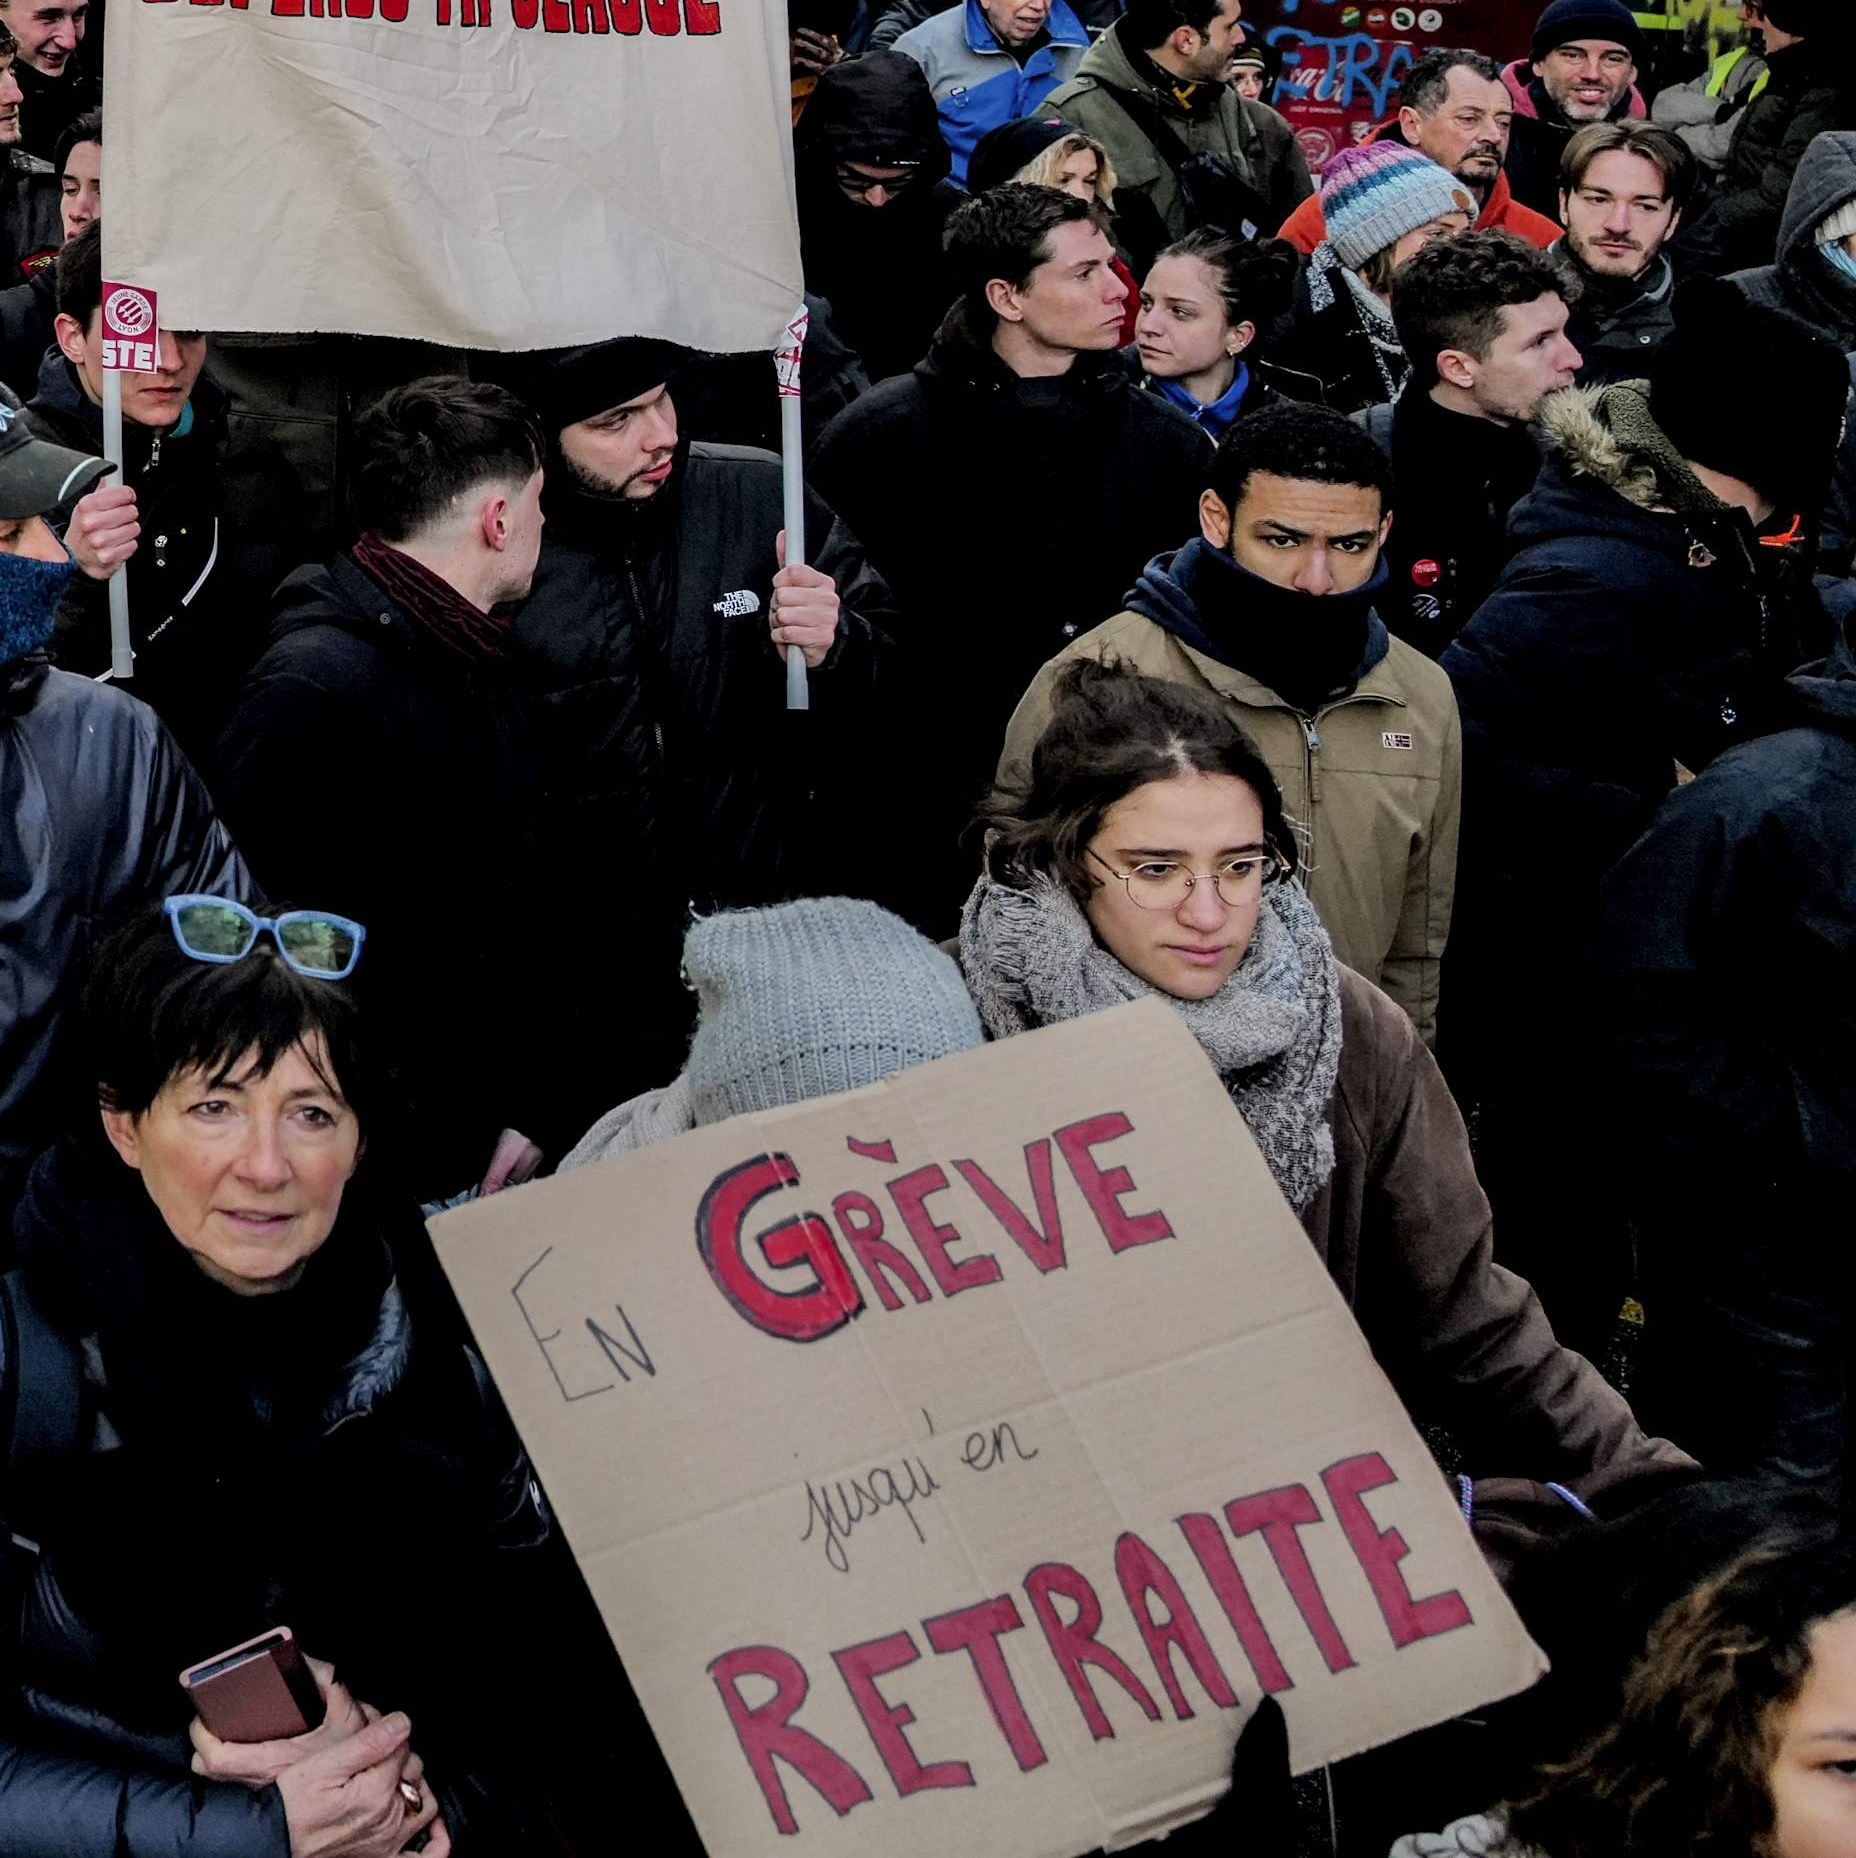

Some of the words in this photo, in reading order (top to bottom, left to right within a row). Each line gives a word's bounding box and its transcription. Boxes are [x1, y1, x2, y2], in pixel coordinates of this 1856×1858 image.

[111, 291, 129, 304] JEUNE
[130, 292, 148, 309] GARDE
[118, 324, 139, 333] LYON
[724, 591, 743, 602] THE
[713, 600, 747, 613] NORTH
[724, 608, 748, 619] FACE
[695, 1110, 1174, 1344] GRÈVE
[706, 1450, 1474, 1835] RETRAITE
